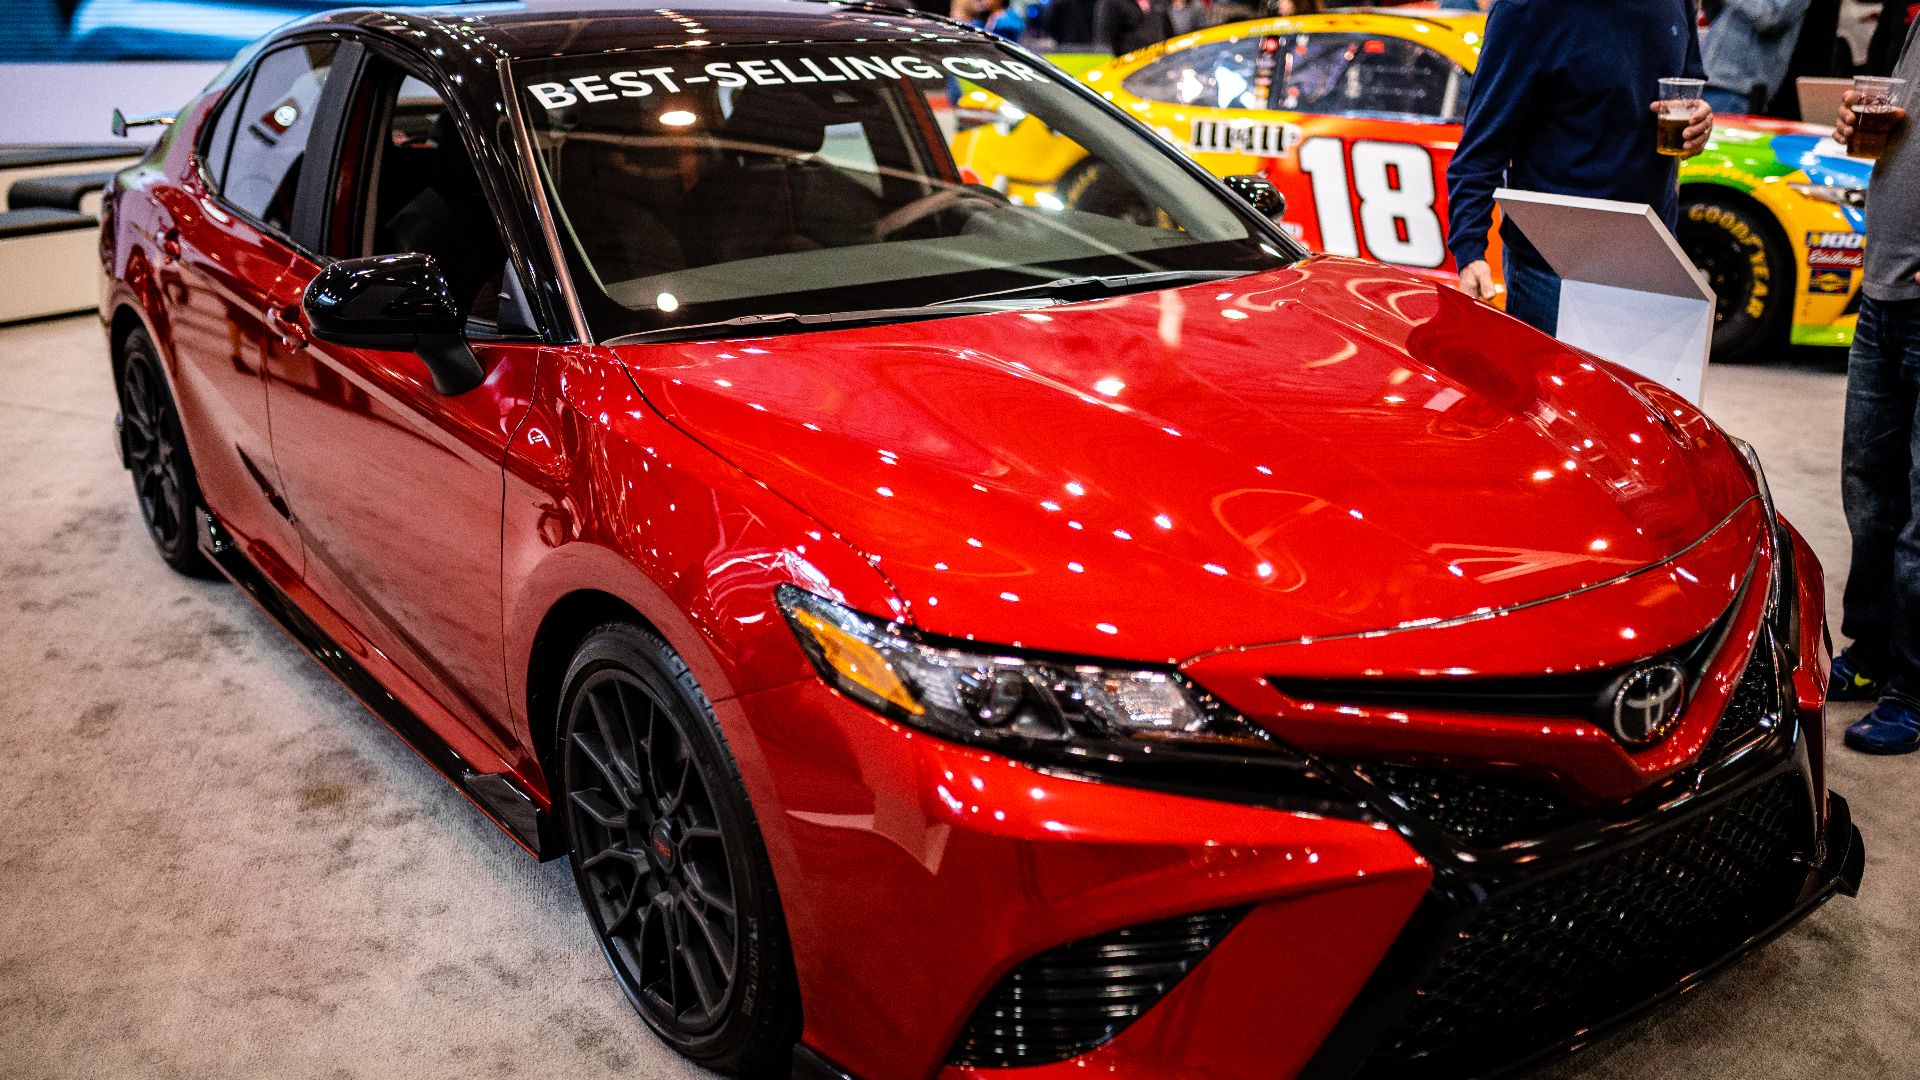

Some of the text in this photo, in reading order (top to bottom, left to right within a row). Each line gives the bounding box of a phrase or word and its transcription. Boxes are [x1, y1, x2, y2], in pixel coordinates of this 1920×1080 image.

[527, 56, 1051, 110] BEST-SELLING CAR
[1298, 136, 1446, 268] 18
